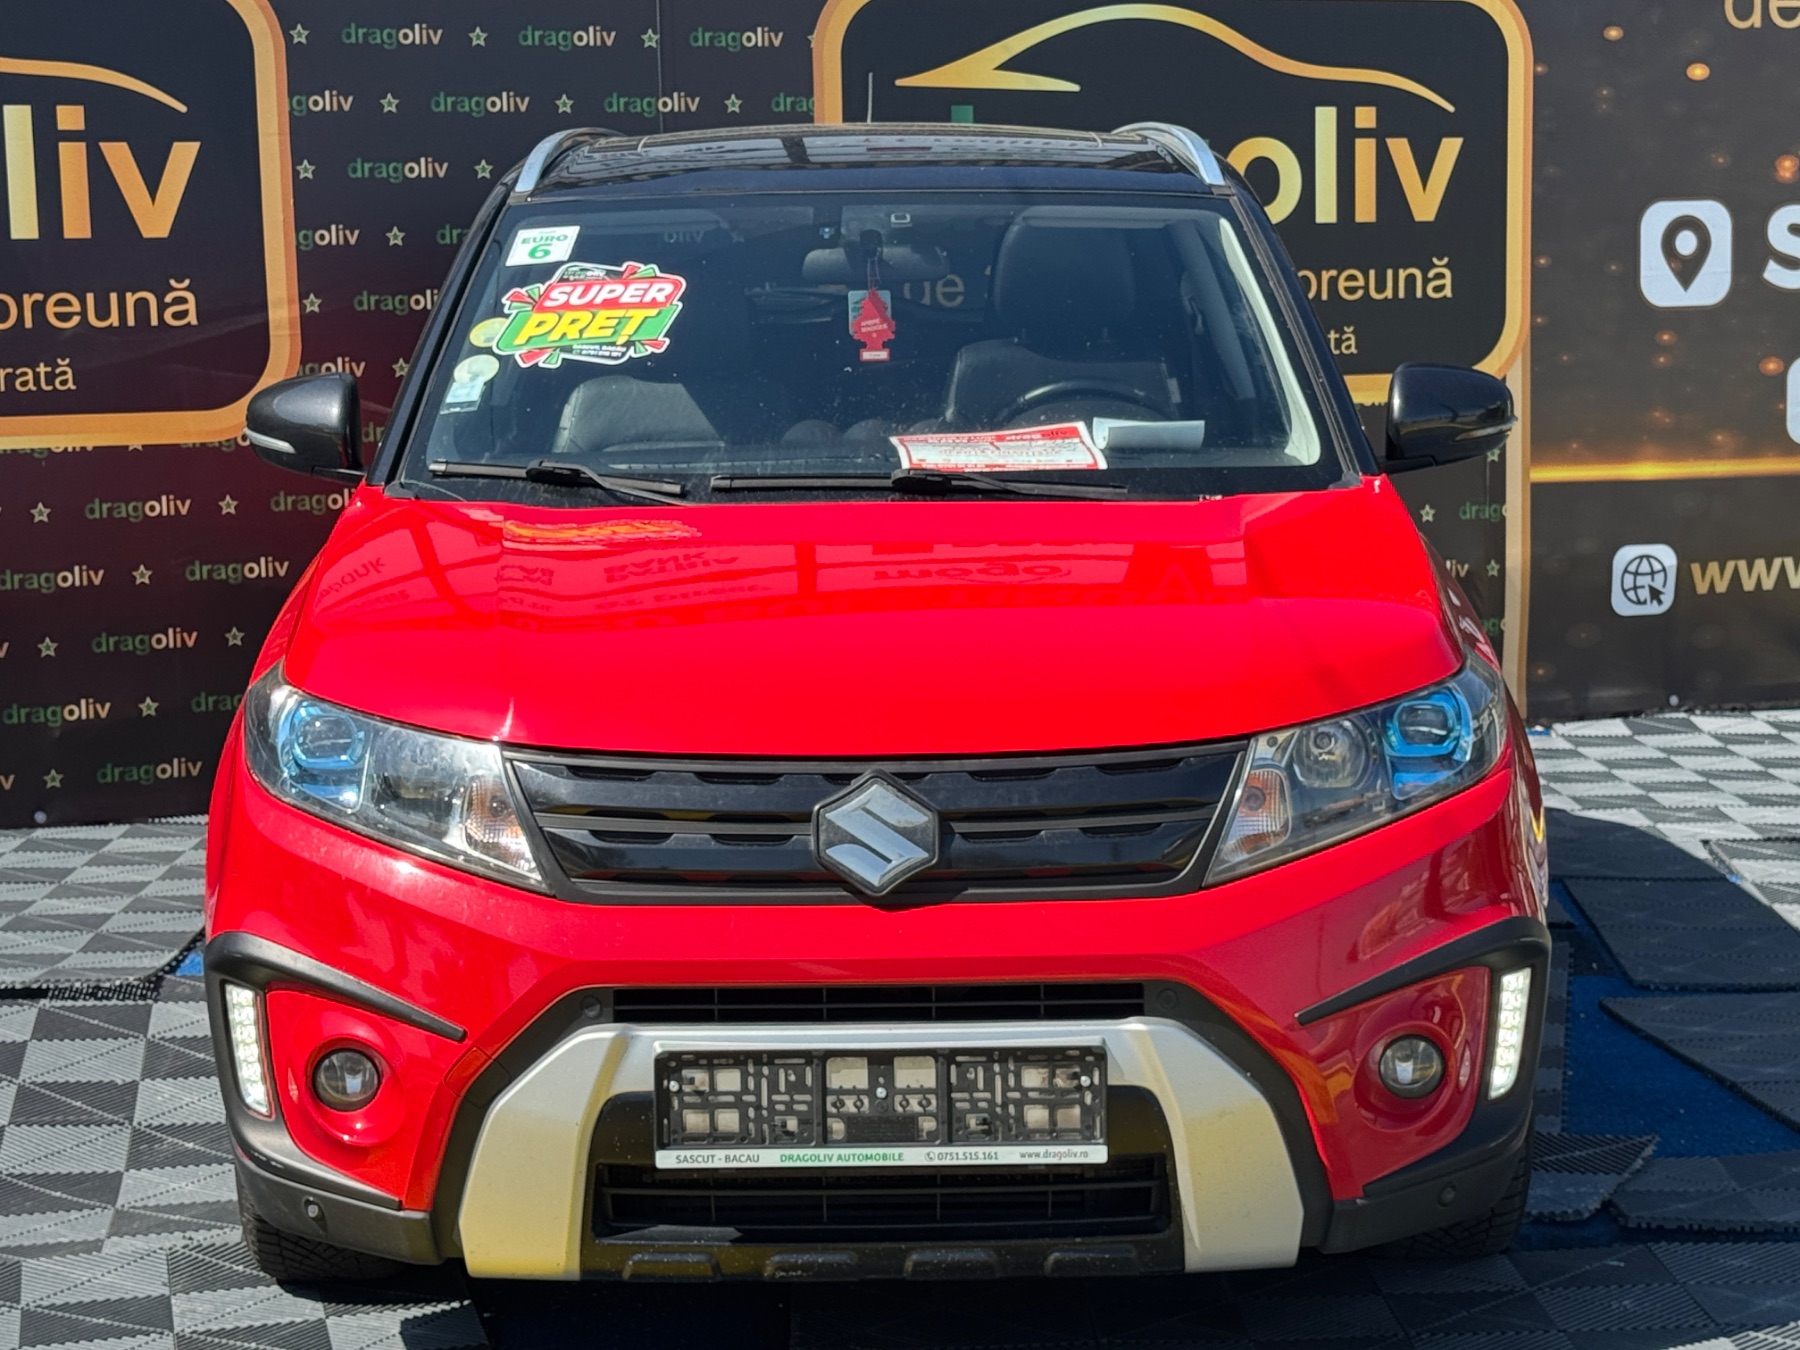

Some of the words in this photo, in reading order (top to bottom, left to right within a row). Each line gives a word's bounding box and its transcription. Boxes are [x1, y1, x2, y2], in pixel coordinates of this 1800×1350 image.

[341, 24, 443, 49] dragoliv
[518, 26, 616, 50] dragoliv
[689, 27, 783, 51] dragoliv
[430, 92, 530, 117] dragoliv
[603, 92, 700, 117] dragoliv
[347, 157, 448, 182] dragoliv
[521, 234, 568, 244] EURO
[528, 243, 553, 259] 6
[543, 282, 675, 307] SUPER
[0, 358, 76, 392] rată
[84, 495, 191, 522] dragoliv
[0, 566, 105, 593] dragoliv
[185, 557, 290, 584] dragoliv
[92, 628, 198, 655] dragoliv
[3, 699, 111, 727] dragoliv
[97, 758, 203, 784] dragoliv
[675, 1154, 716, 1164] SASCUT
[724, 1154, 760, 1164] BACAU
[779, 1153, 835, 1163] DRAGOLIV
[836, 1152, 905, 1162] AUTOMOBILE
[937, 1152, 999, 1161] 0751.515.161
[1019, 1149, 1089, 1161] www.dragoliv.ro
